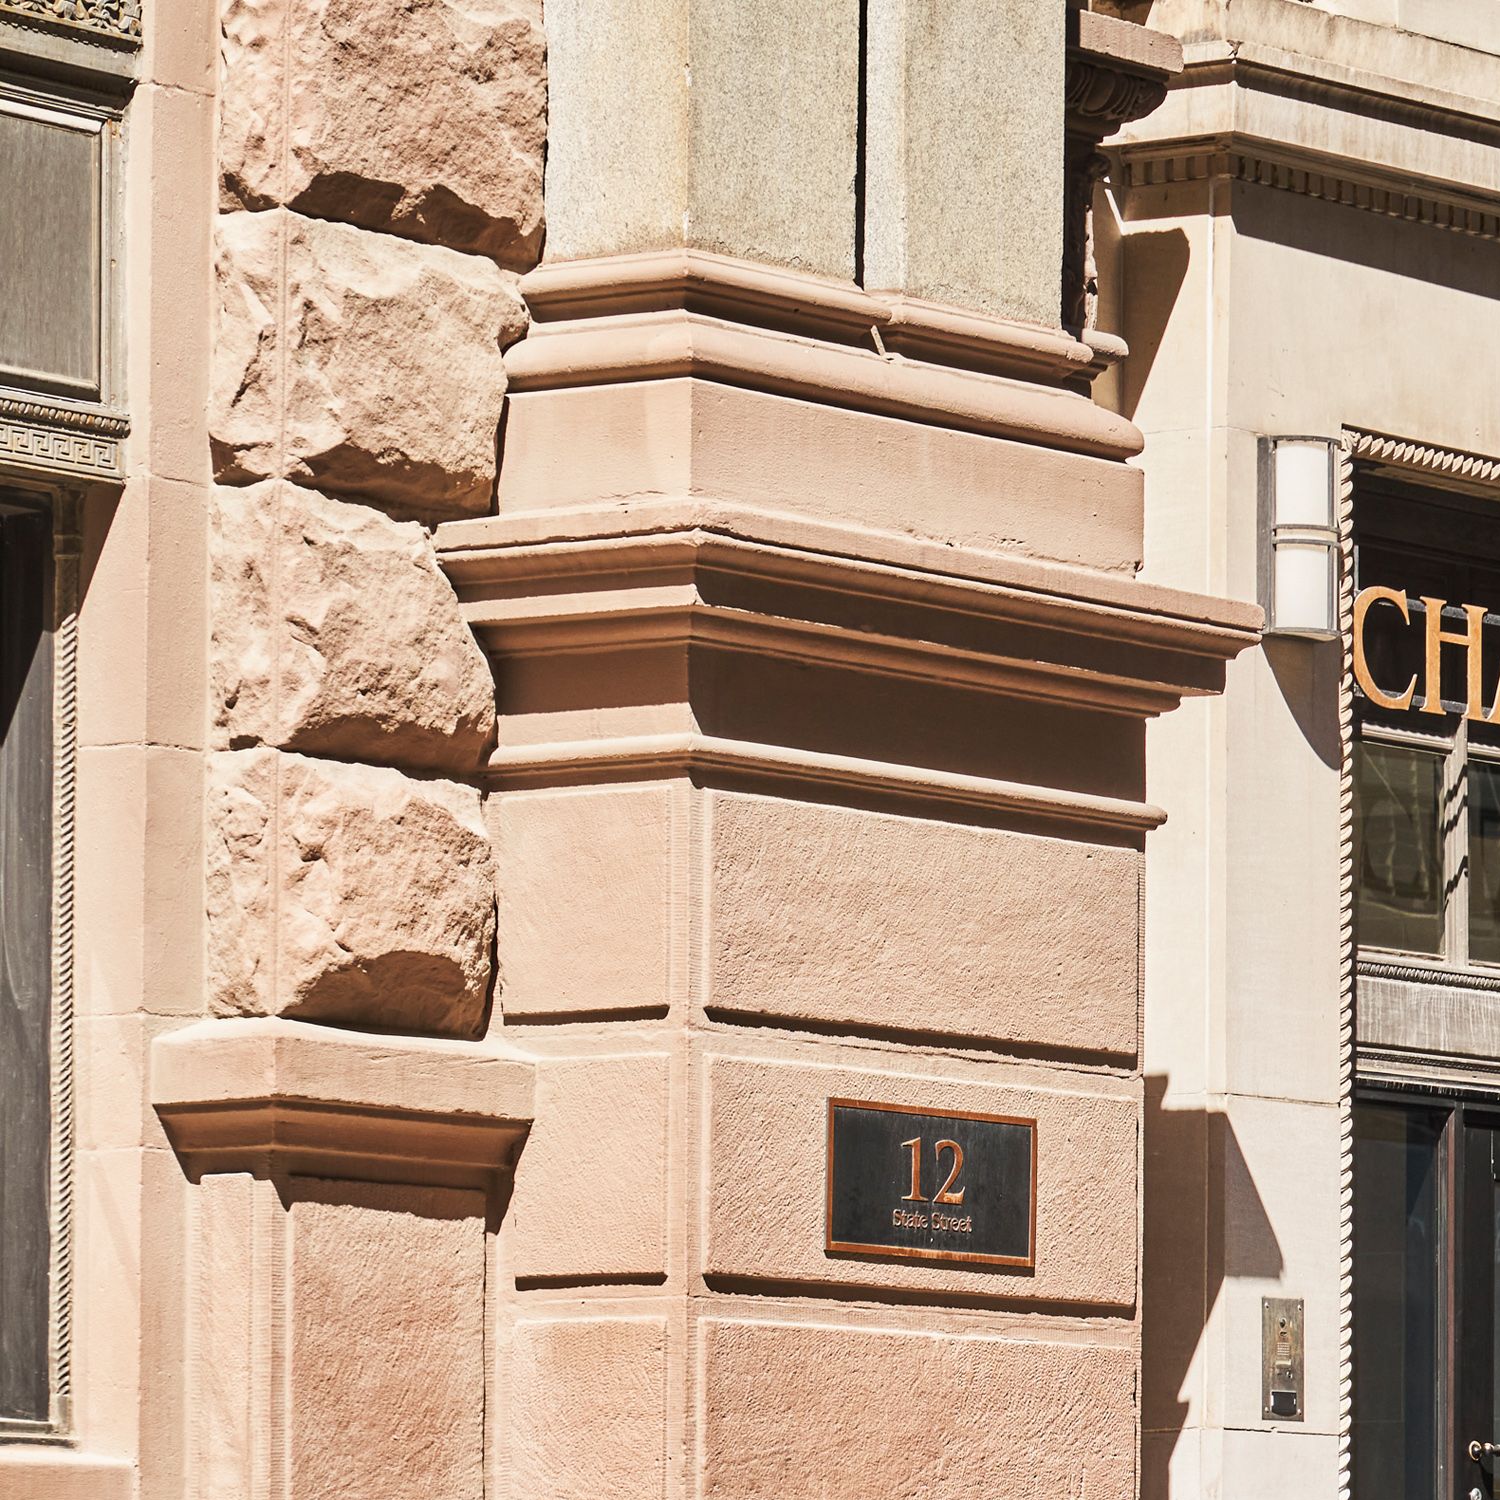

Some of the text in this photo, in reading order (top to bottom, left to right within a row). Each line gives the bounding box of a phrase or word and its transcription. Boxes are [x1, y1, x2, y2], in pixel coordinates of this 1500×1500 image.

[901, 1136, 966, 1206] 12
[892, 1208, 973, 1234] State Street
